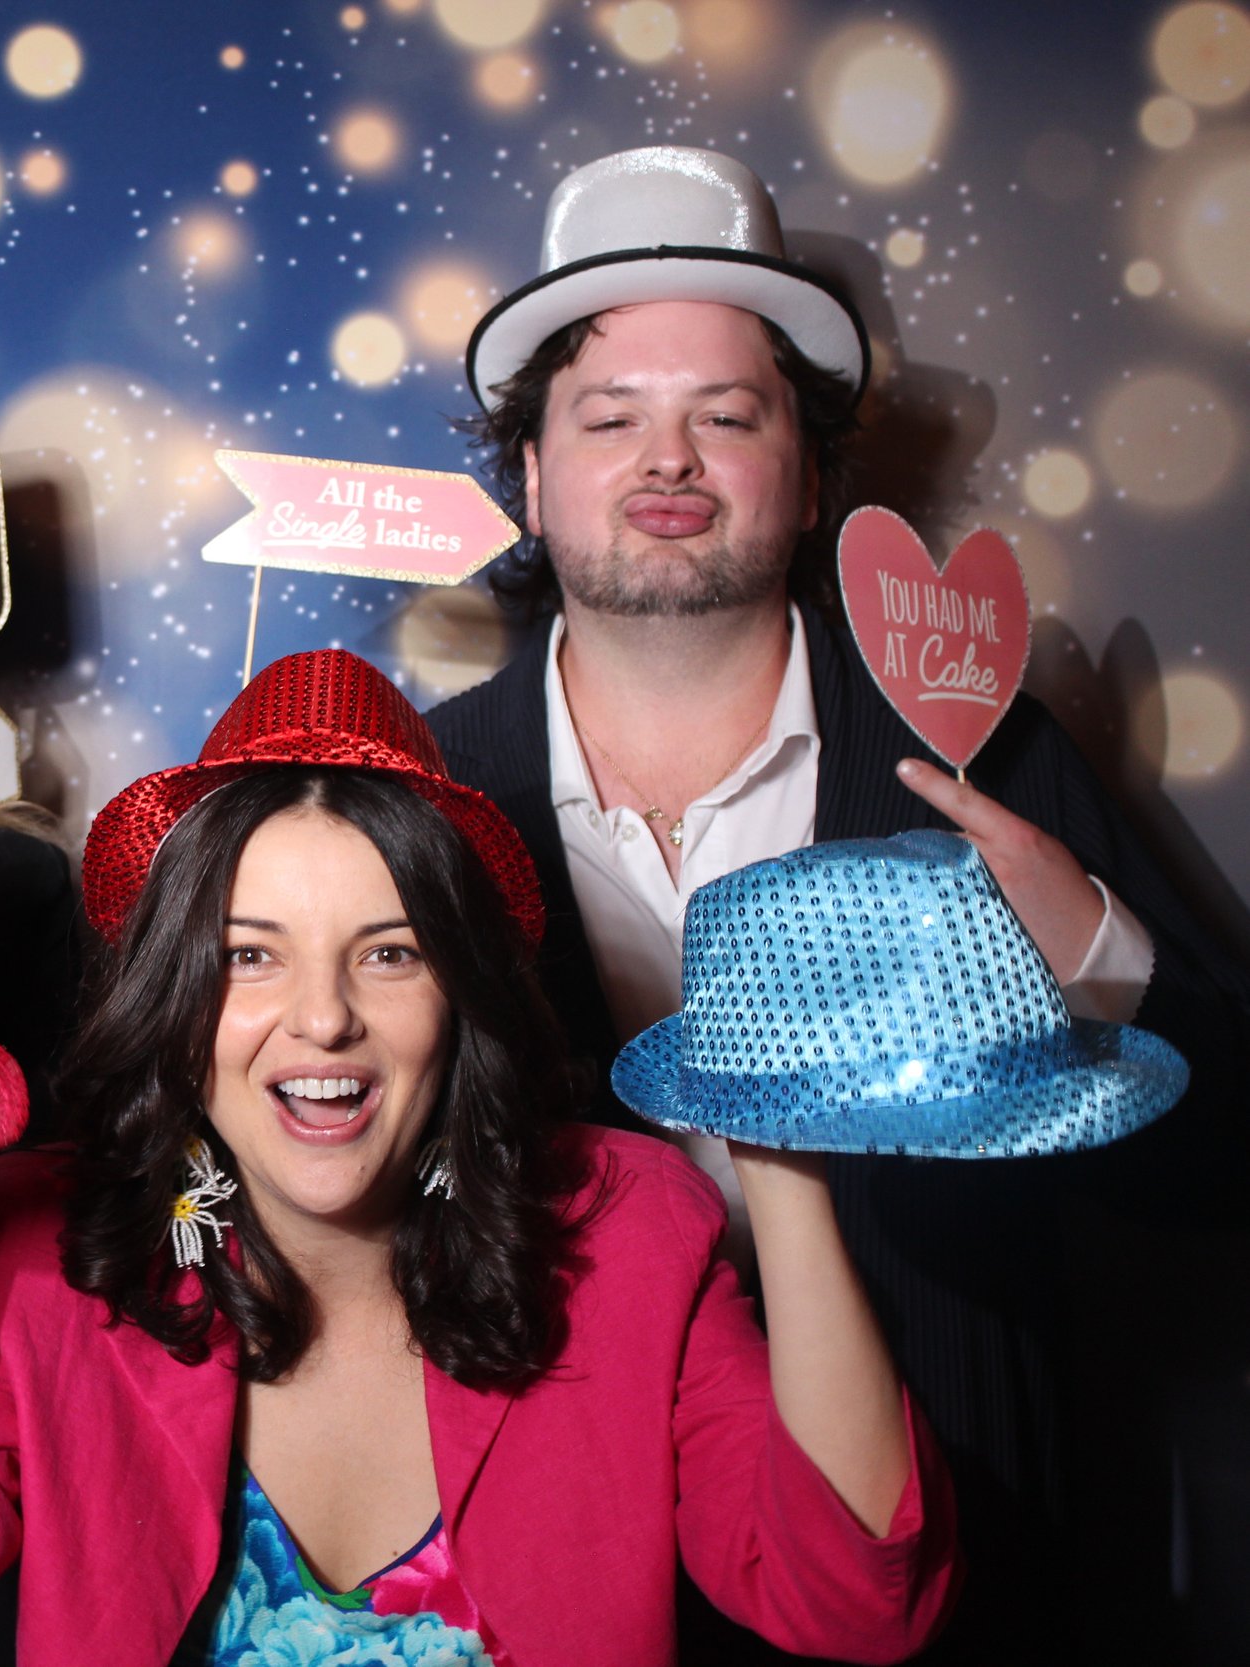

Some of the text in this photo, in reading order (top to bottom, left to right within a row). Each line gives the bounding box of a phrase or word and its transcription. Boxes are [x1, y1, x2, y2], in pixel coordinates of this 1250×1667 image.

[315, 477, 422, 513] All the
[267, 501, 462, 553] Single ladies
[877, 569, 1001, 643] YOU HAD ME
[884, 631, 999, 695] AT Cake
